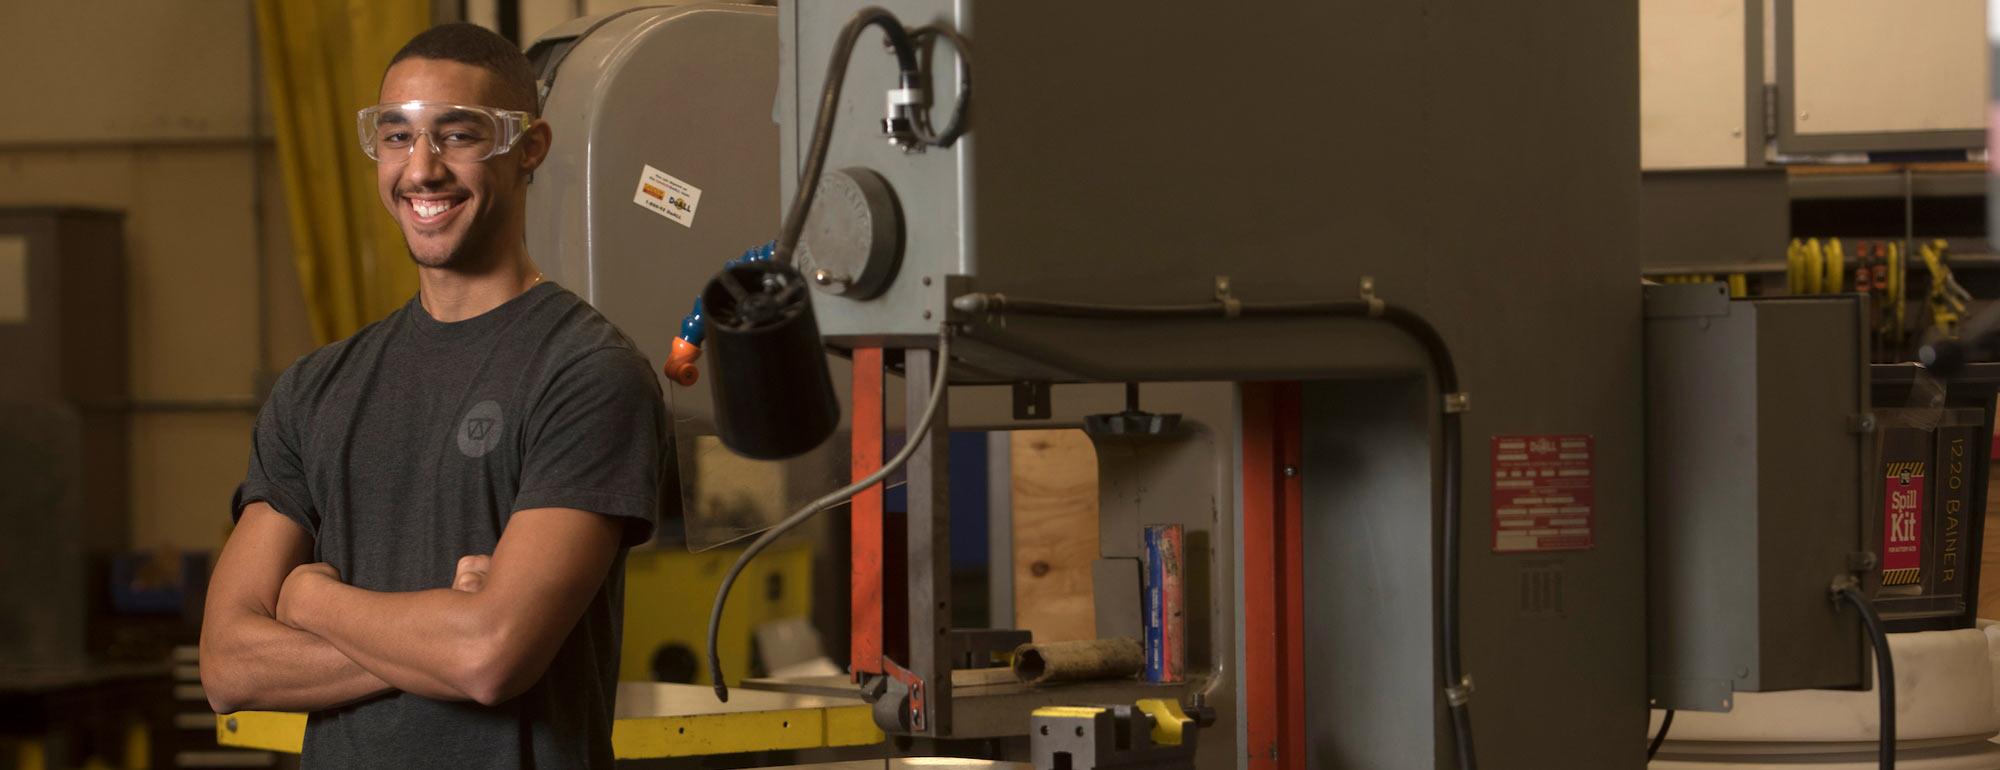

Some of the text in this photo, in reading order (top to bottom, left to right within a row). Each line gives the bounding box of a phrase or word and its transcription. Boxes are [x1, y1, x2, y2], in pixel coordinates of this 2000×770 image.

[1891, 490, 1917, 513] Spill
[1943, 439, 1963, 582] 1220 BAINER
[1891, 511, 1916, 541] Kit
